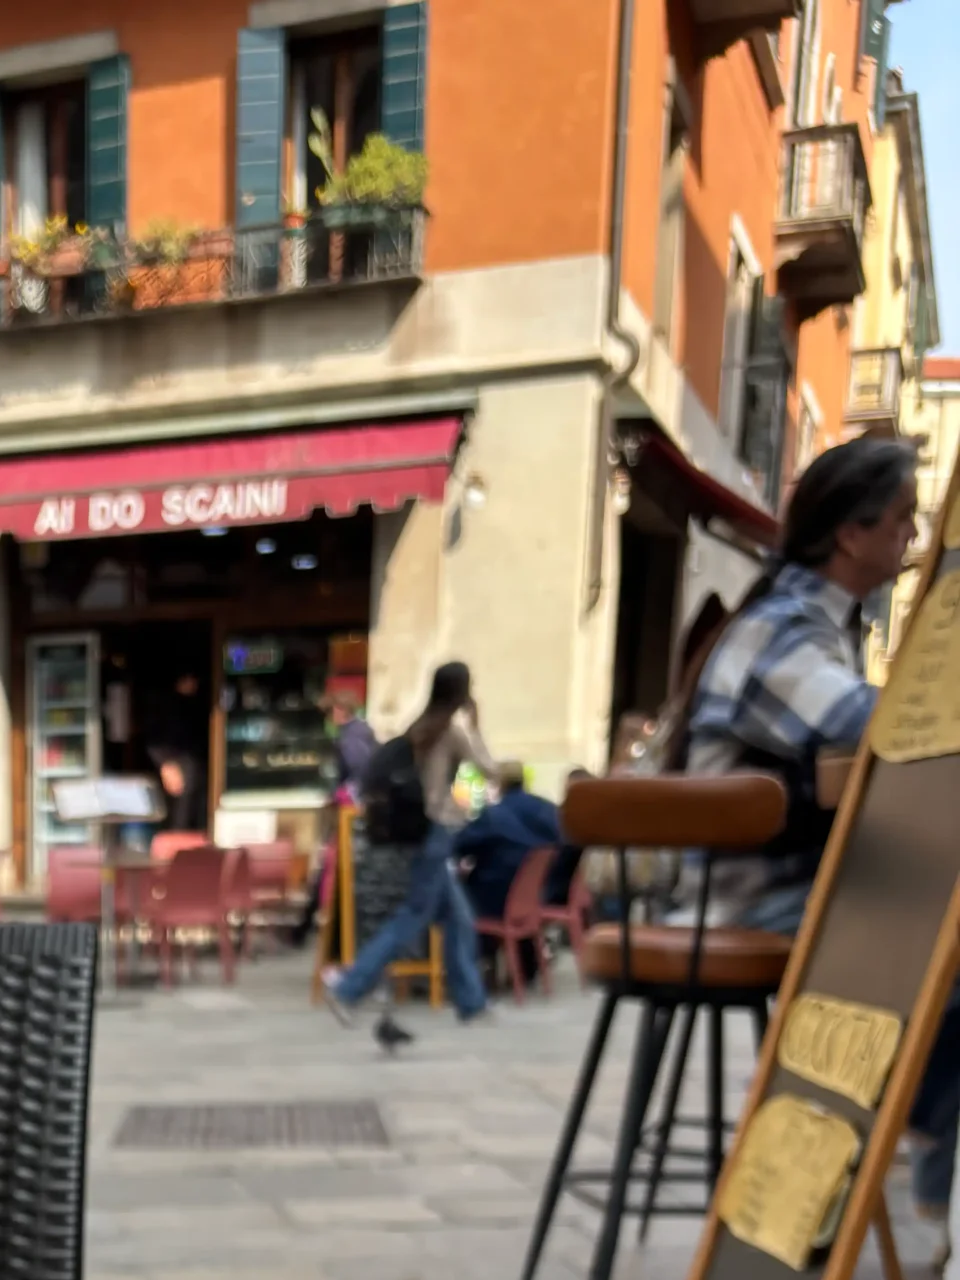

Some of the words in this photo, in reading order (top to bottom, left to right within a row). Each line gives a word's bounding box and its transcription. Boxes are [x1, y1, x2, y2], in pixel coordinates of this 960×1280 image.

[34, 497, 75, 536] AI
[88, 490, 145, 531] DO
[161, 479, 288, 525] SCAINI
